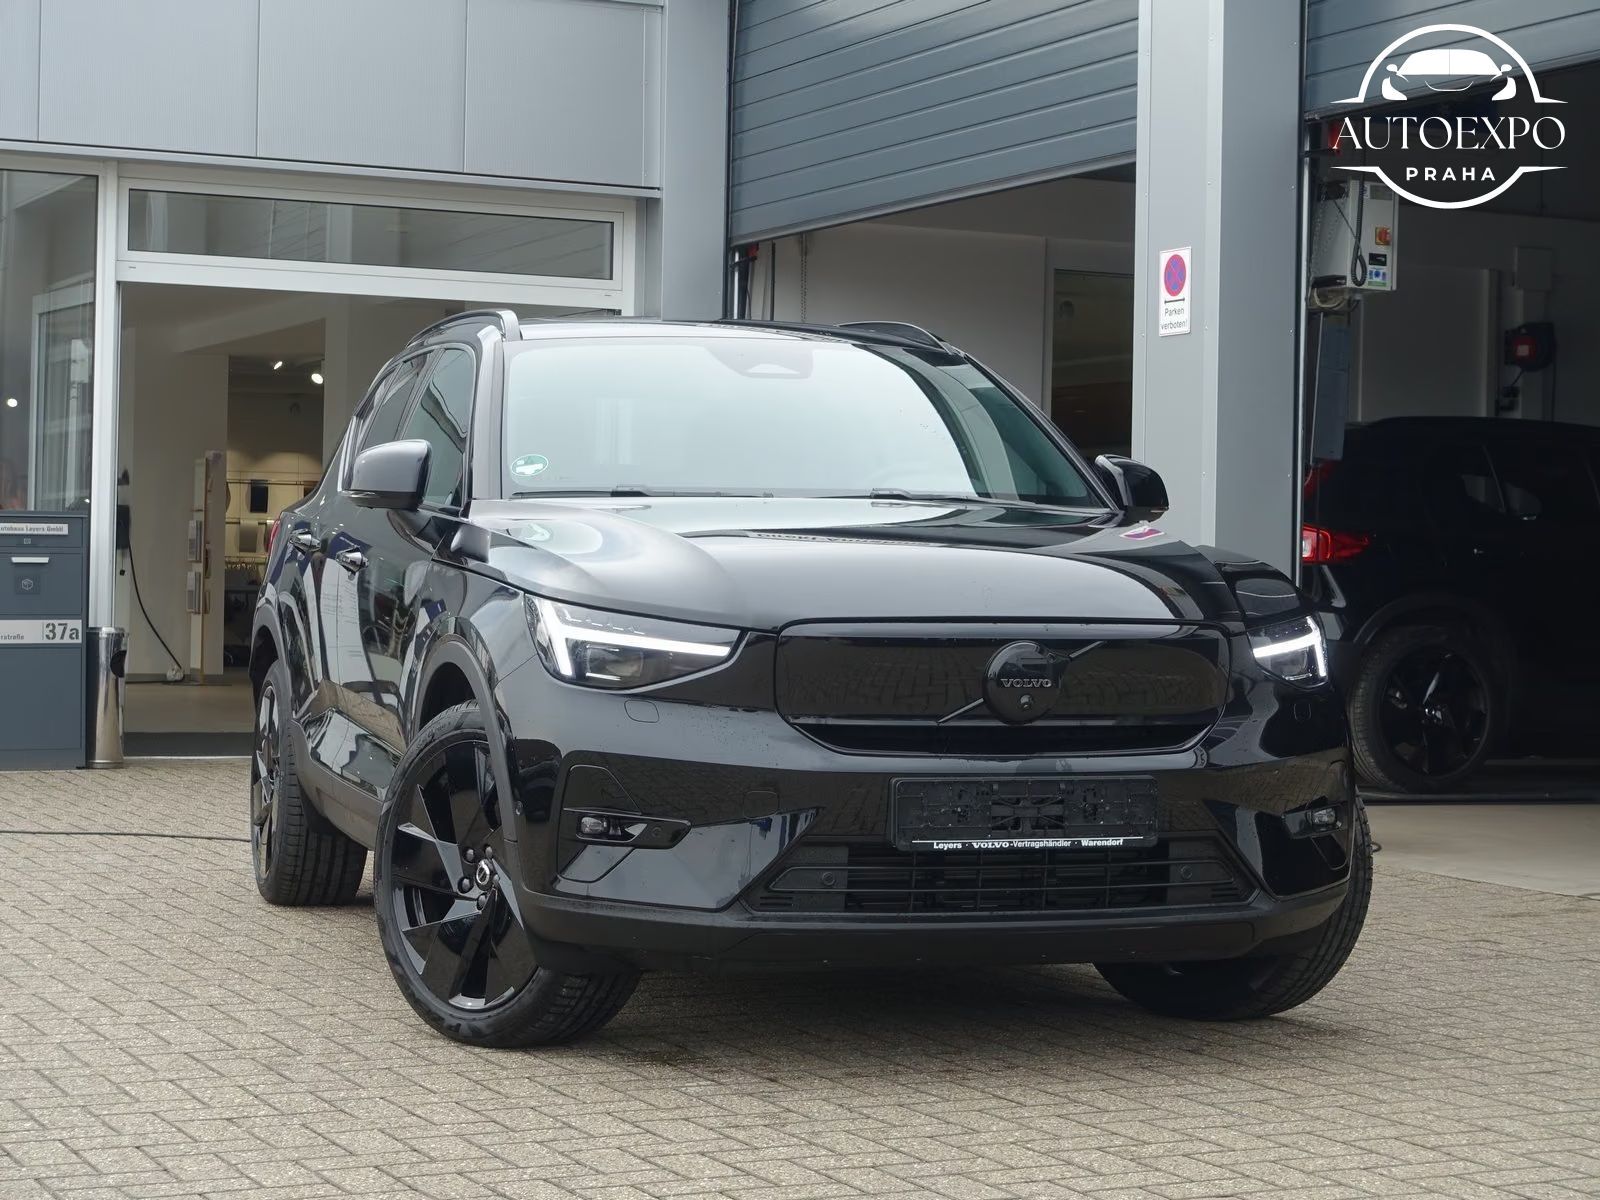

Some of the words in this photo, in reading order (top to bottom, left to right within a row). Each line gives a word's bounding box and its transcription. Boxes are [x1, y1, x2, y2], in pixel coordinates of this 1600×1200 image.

[1165, 307, 1185, 316] Parken
[45, 622, 80, 640] 37a
[1000, 678, 1052, 688] VOLVO
[933, 841, 962, 850] Leyers
[1080, 838, 1124, 847] Warendorf
